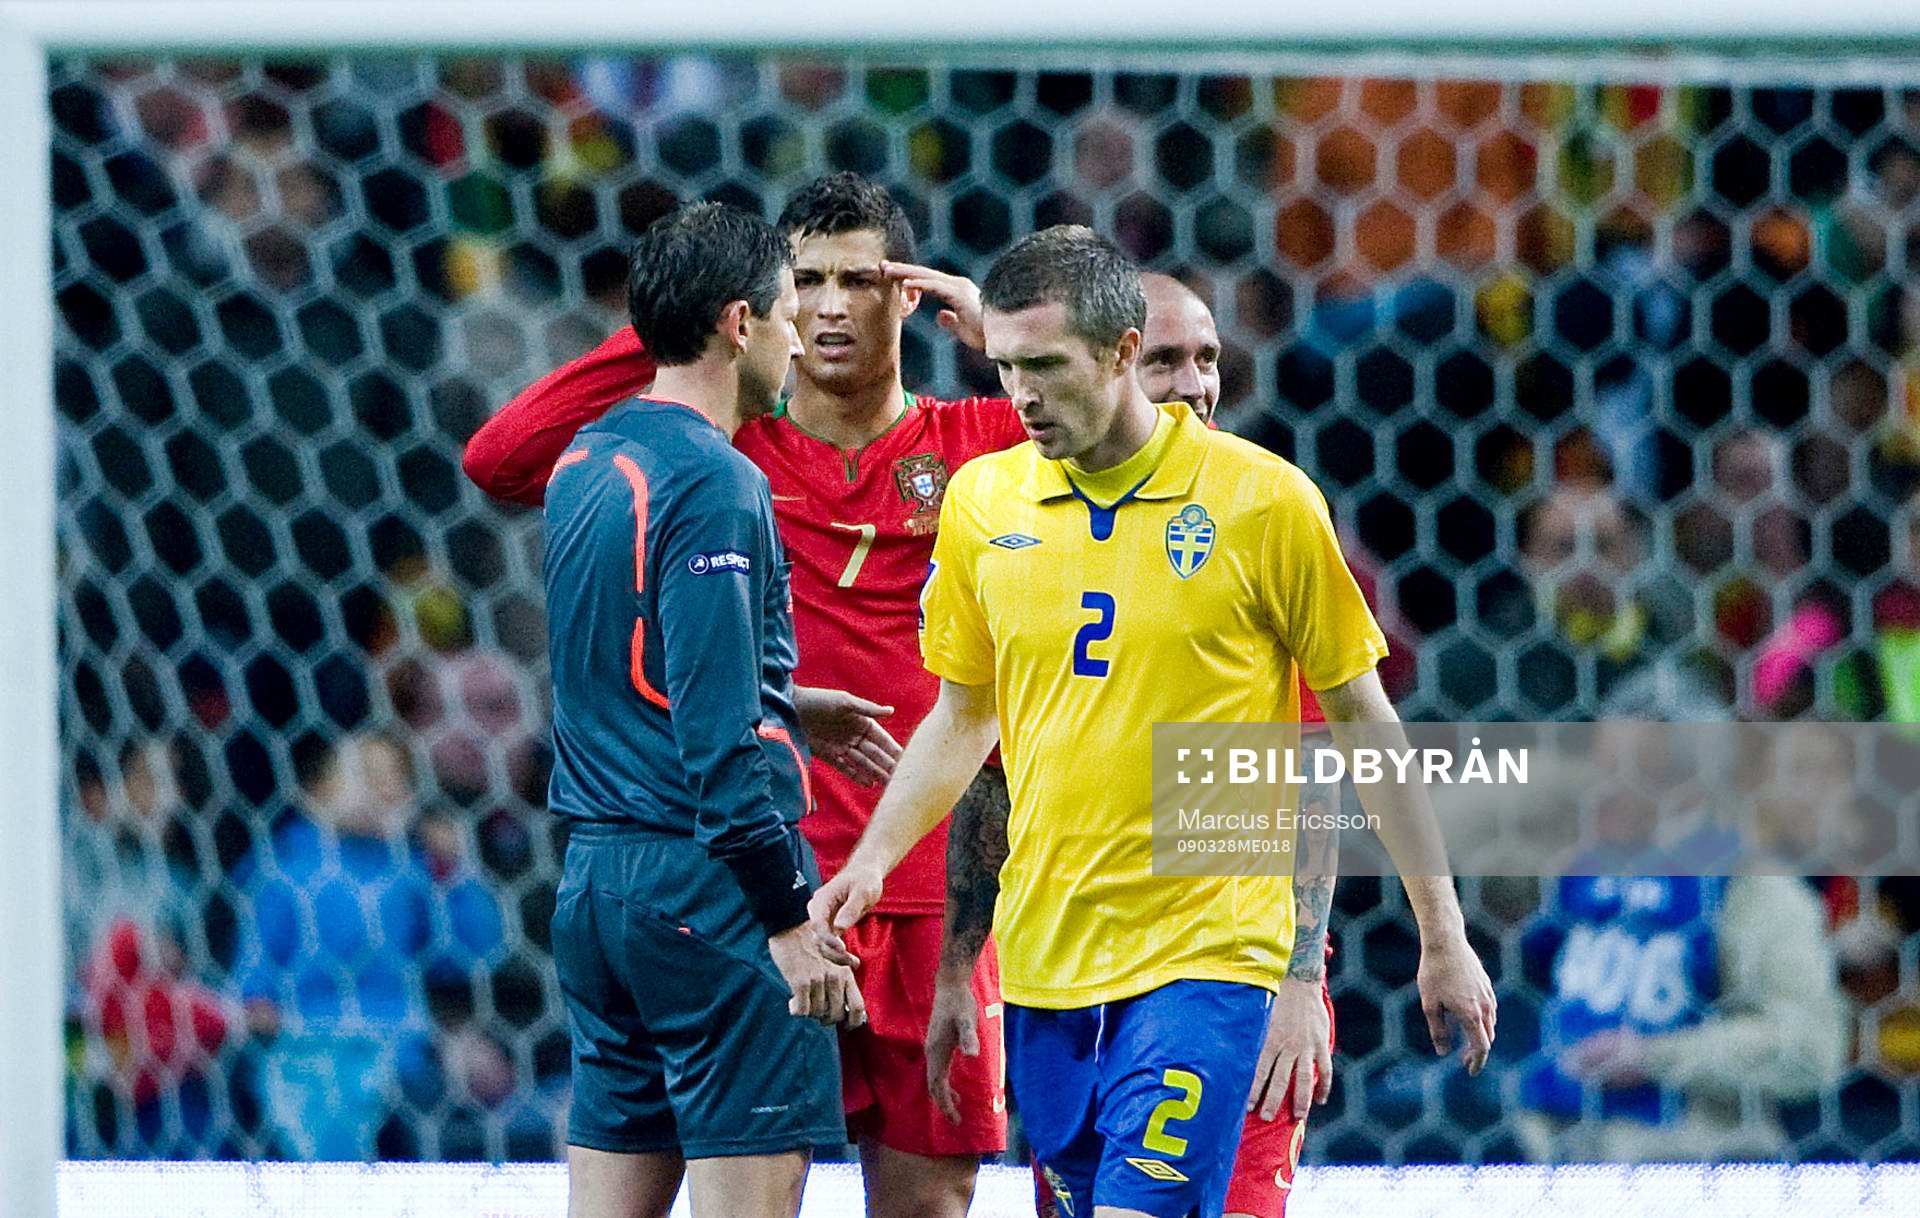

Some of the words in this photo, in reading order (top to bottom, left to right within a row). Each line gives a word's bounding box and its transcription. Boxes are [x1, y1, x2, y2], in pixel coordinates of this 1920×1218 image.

[711, 553, 751, 570] RESPECT
[831, 522, 876, 588] 7
[1073, 592, 1116, 677] 2
[1143, 1069, 1203, 1157] 2
